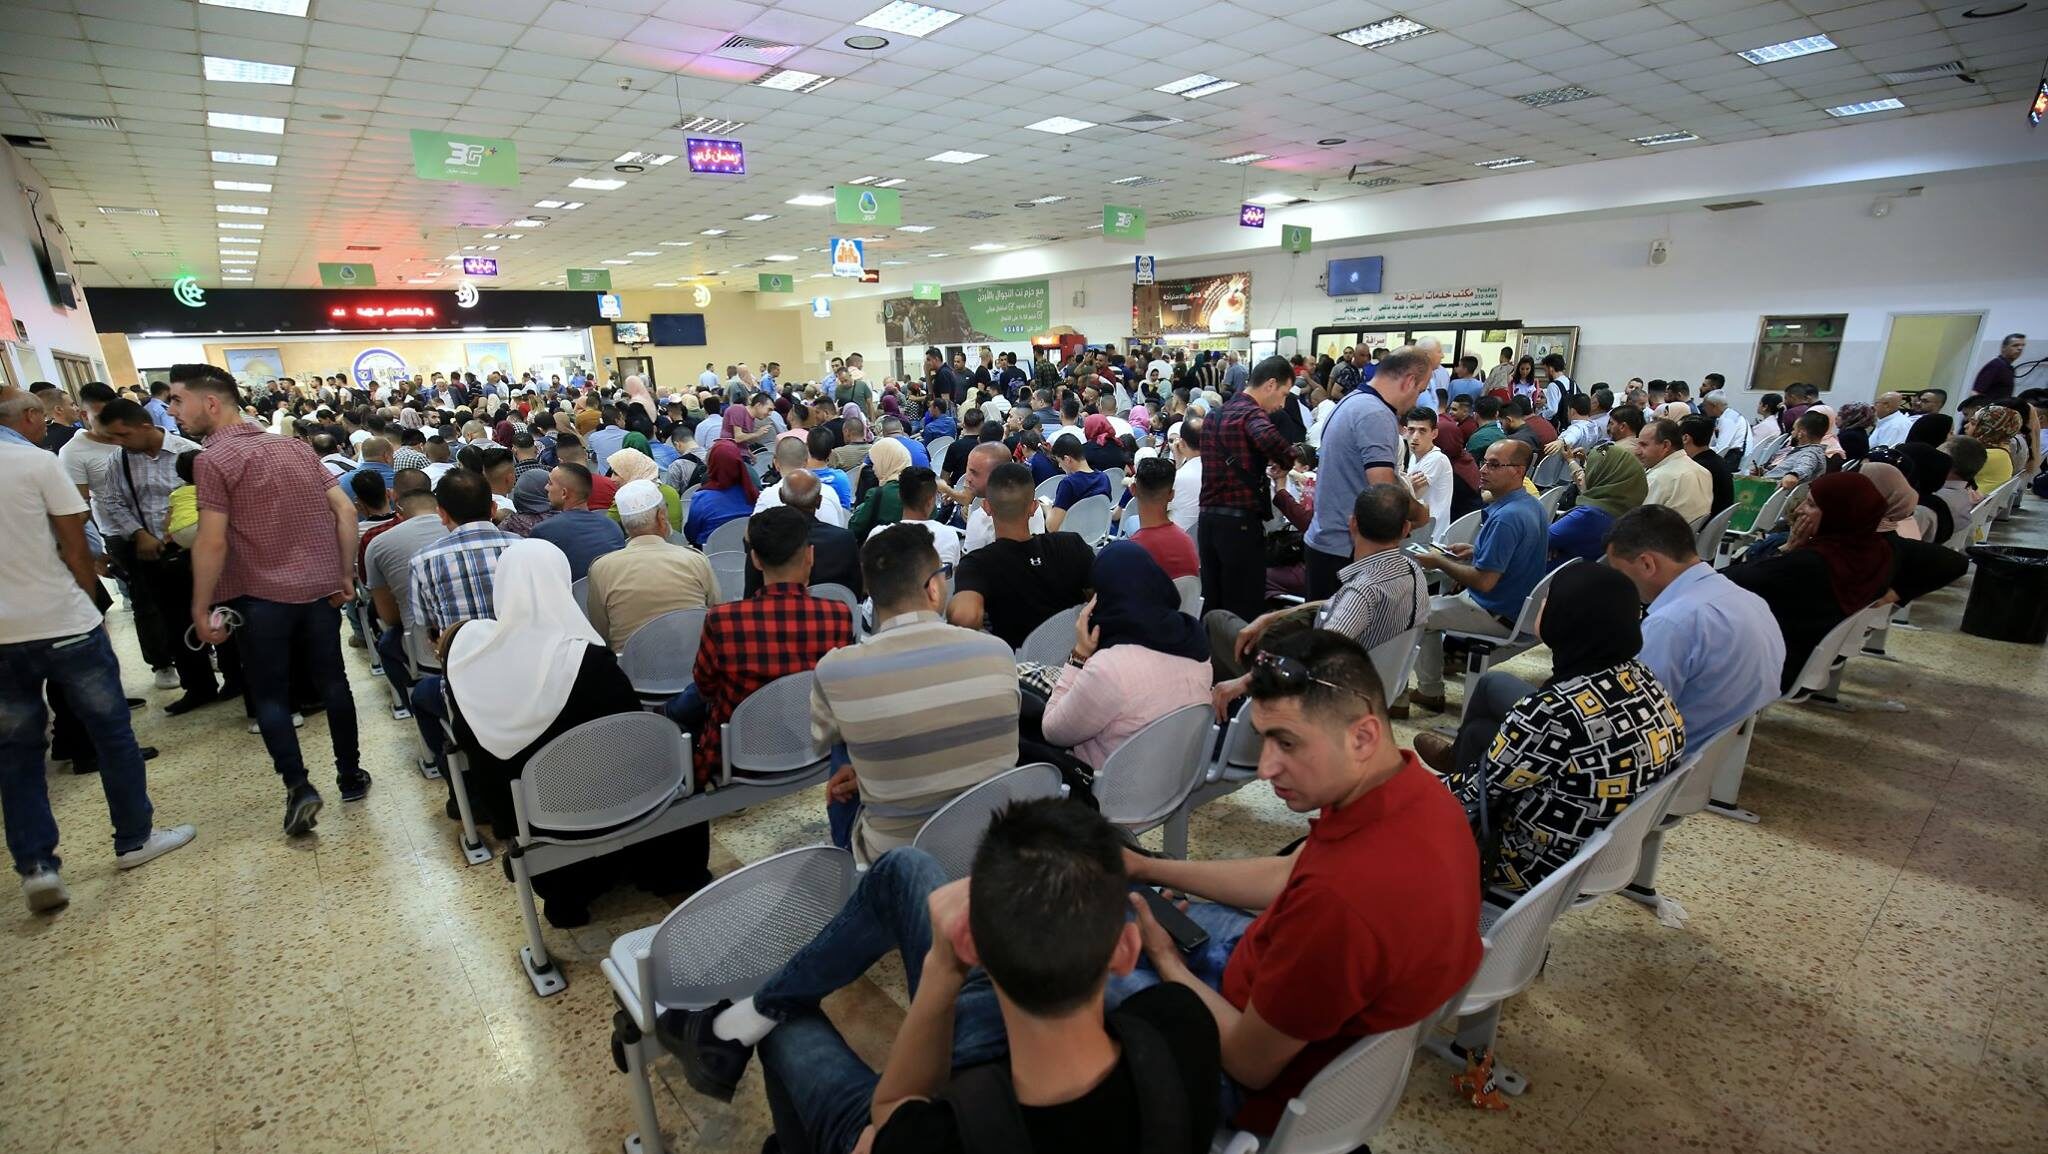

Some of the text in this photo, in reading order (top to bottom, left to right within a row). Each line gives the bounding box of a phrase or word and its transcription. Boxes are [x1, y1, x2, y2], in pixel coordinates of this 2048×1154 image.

[444, 141, 485, 167] 3G
[1115, 212, 1132, 228] 3G
[1014, 289, 1023, 297] نت
[1024, 288, 1035, 298] حزم
[1035, 287, 1044, 297] مع
[1394, 288, 1474, 303] مكتب خدمات استراحة
[1366, 335, 1385, 345] صرافة
